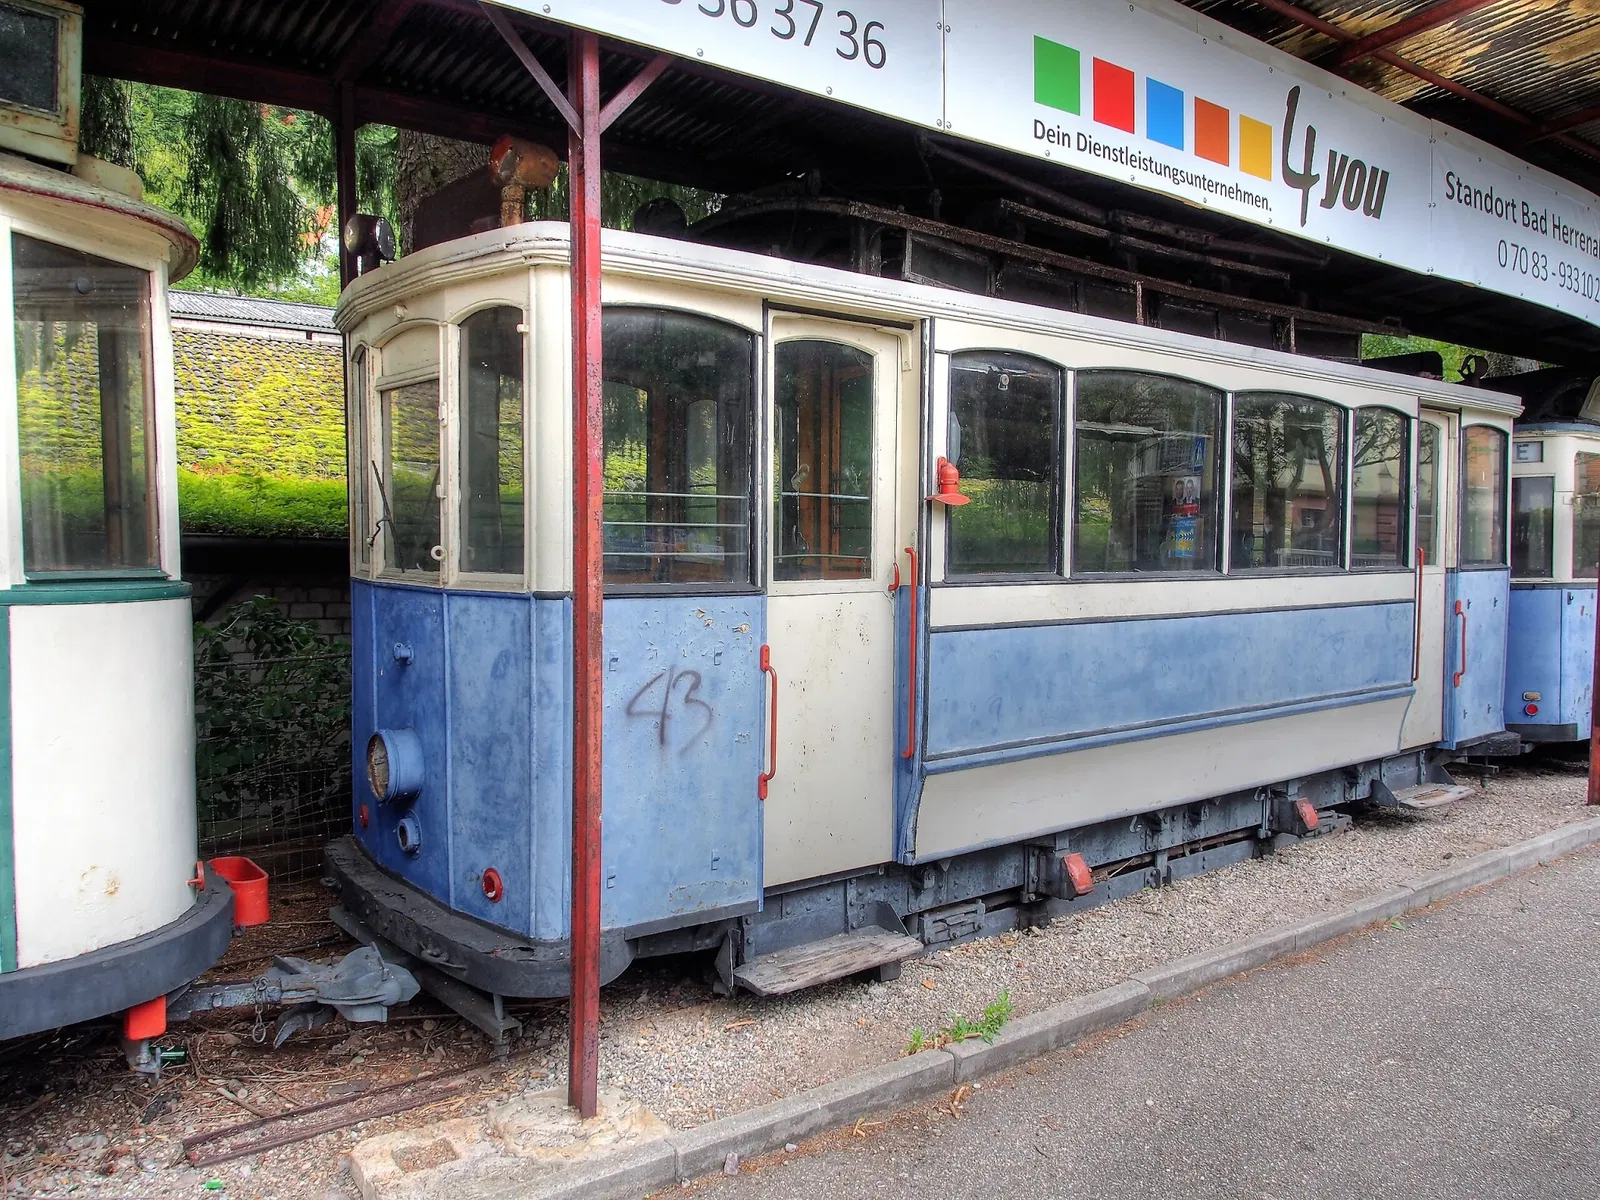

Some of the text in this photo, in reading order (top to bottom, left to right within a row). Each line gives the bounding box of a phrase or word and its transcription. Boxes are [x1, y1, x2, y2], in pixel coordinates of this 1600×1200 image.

[1033, 119, 1273, 213] Dein Dienstleistungsunternehmen.
[1445, 171, 1517, 224] Standort
[1521, 201, 1548, 236] Bad
